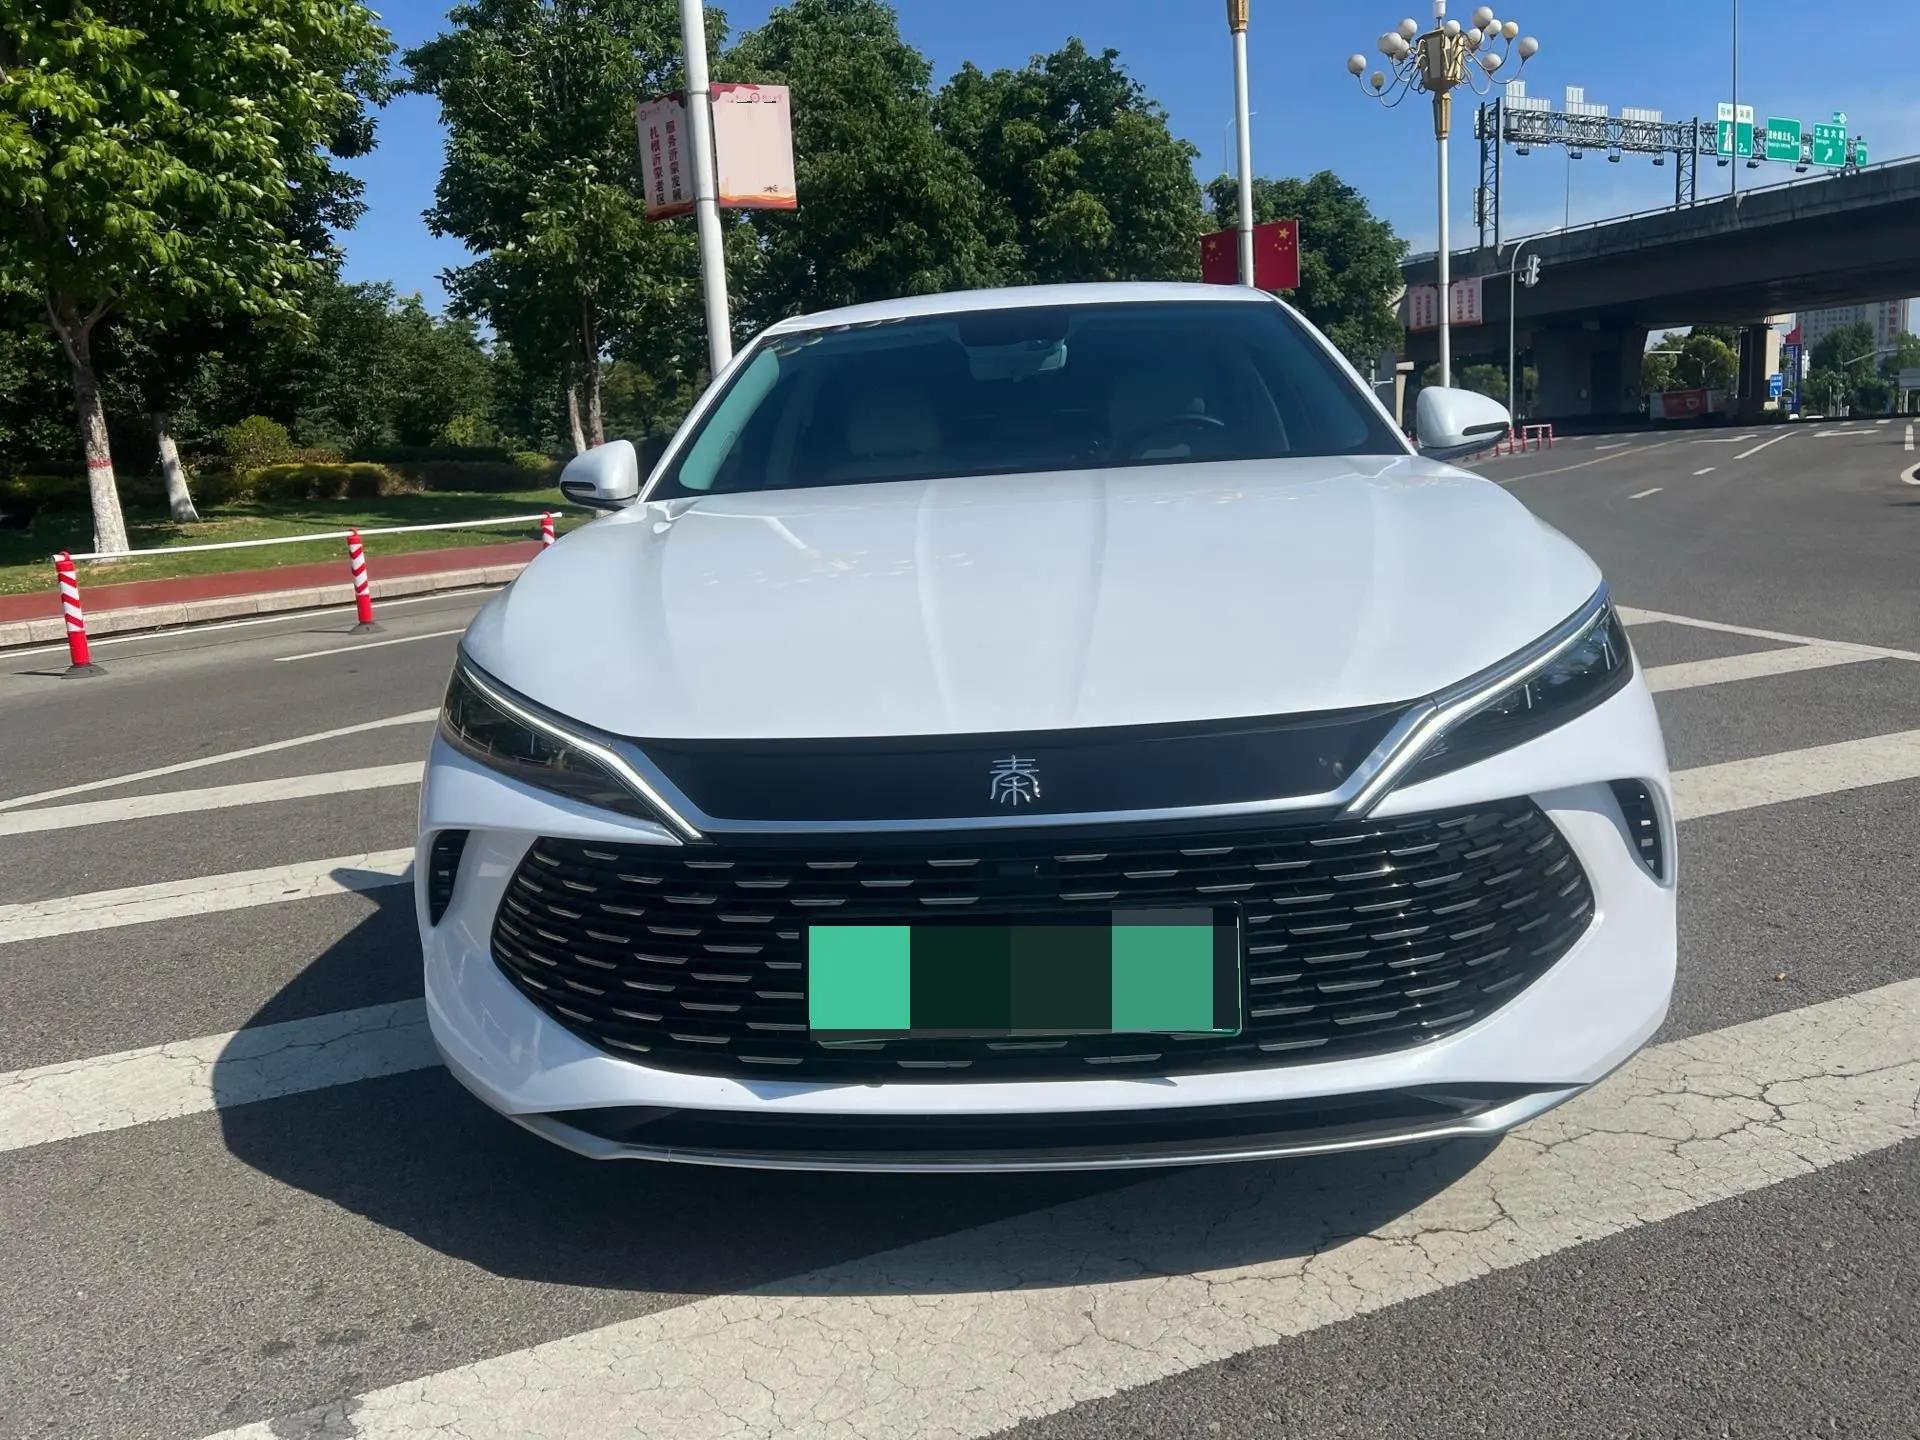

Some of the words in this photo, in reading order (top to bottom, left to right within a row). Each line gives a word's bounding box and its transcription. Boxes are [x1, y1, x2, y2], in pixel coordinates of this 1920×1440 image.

[665, 119, 682, 201] 服务沂蒙发展
[989, 754, 1041, 807] 秦
